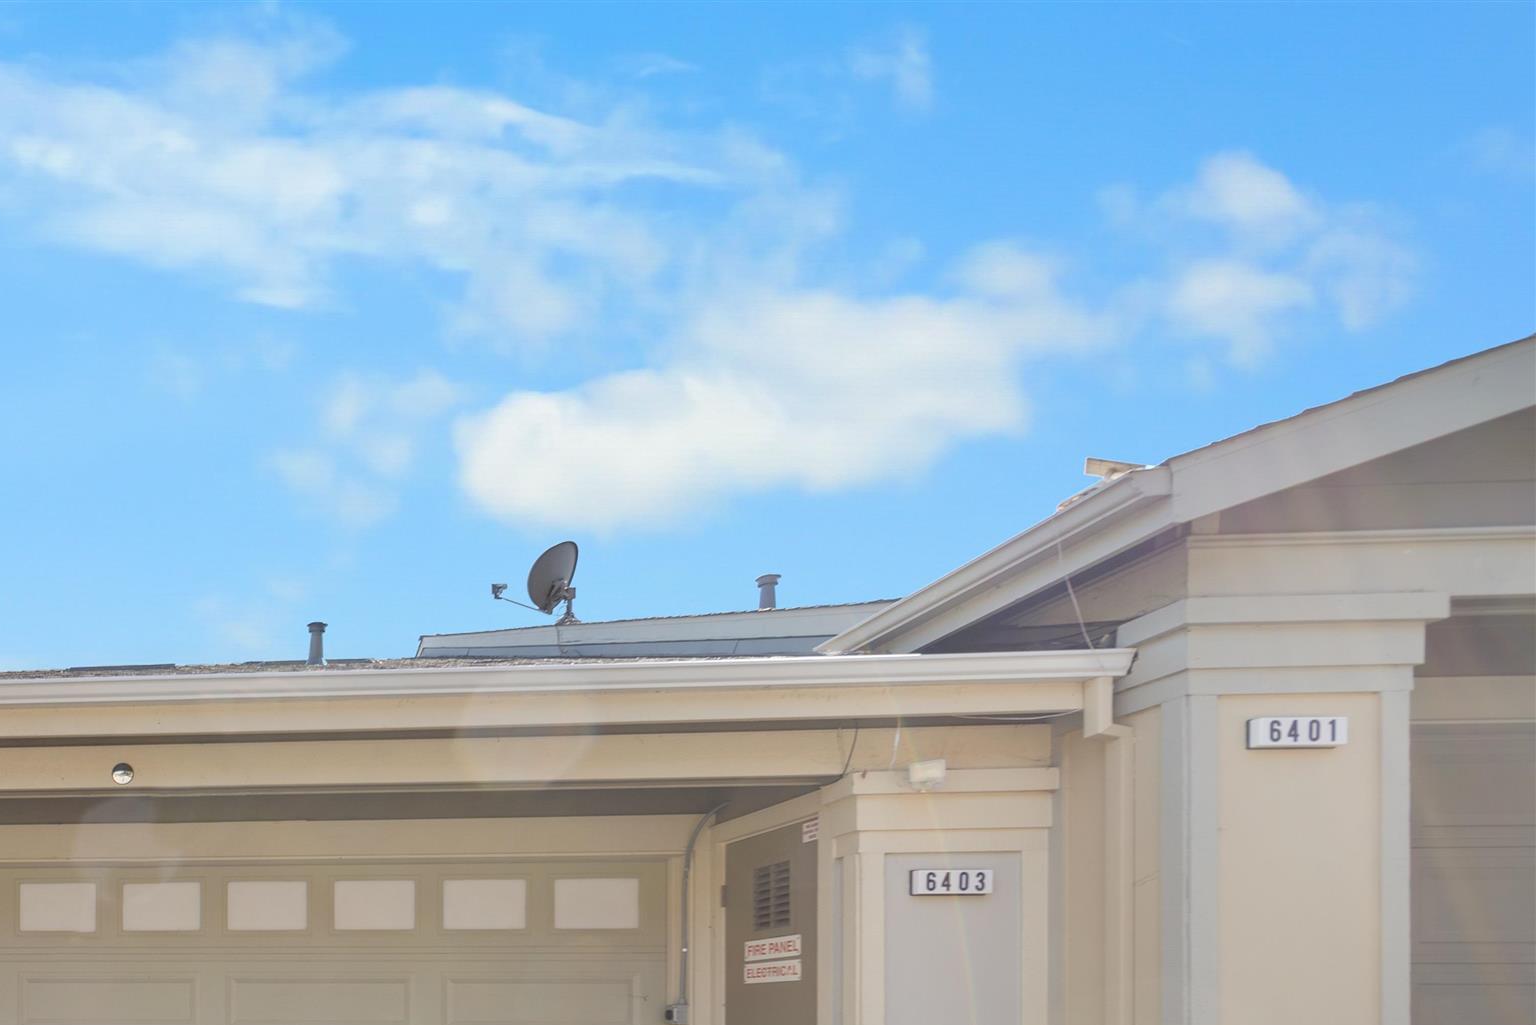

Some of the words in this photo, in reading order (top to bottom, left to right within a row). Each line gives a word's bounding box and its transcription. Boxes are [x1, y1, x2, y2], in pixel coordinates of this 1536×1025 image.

[1270, 720, 1336, 742] 6401
[926, 872, 985, 891] 6403
[747, 944, 767, 956] FIRE
[769, 940, 799, 954] PANEL
[747, 965, 799, 979] ELECTRICAL
